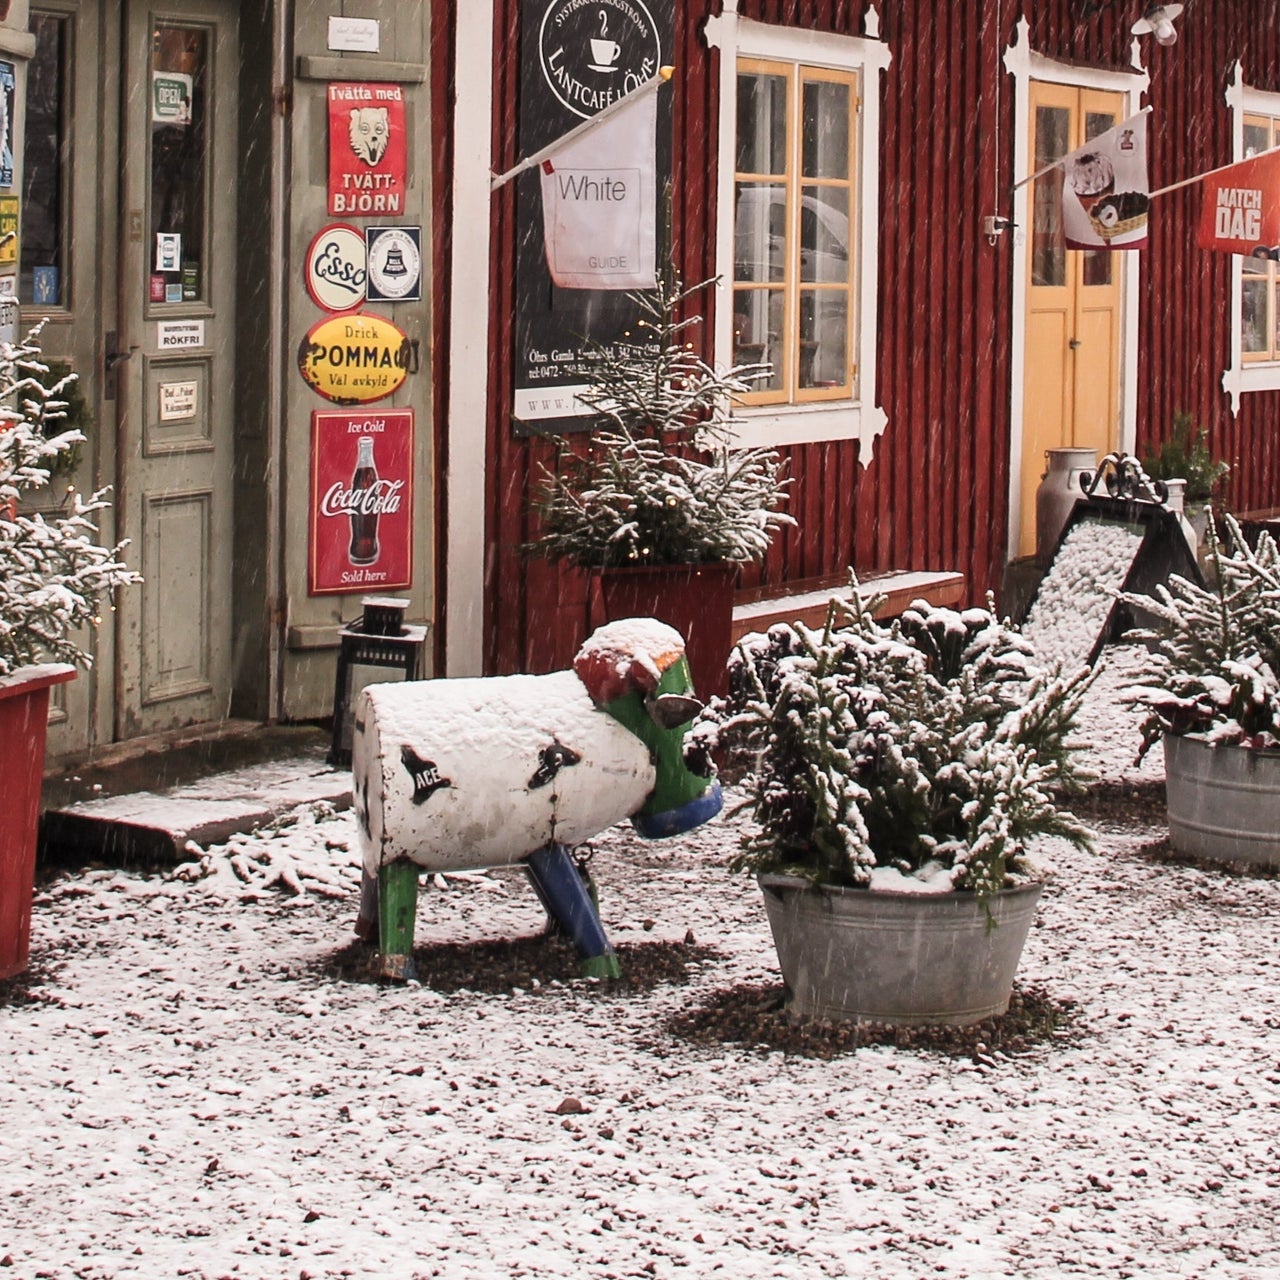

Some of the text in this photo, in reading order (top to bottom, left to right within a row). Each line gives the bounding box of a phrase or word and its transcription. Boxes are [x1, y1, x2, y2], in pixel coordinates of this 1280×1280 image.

[548, 46, 613, 109] LANTCAFÉ
[624, 57, 655, 96] ÖHR
[159, 87, 181, 104] OPEN
[328, 86, 402, 101] Tvätta med
[342, 171, 396, 189] TVÄTT-
[558, 175, 626, 201] White
[333, 190, 400, 212] BJÖRN
[1217, 187, 1262, 209] MATCH
[1215, 207, 1262, 241] DAG
[315, 242, 366, 293] Esso
[588, 256, 627, 269] GUIDE
[163, 335, 200, 345] RÖKFRI
[345, 325, 379, 339] Drick
[529, 349, 548, 363] Öhrs
[551, 349, 575, 362] Gamla
[352, 374, 388, 388] avkyld
[347, 420, 386, 433] Ice Cold
[321, 479, 405, 517] Coca-Cola
[340, 569, 387, 584] Sold here
[415, 767, 442, 789] ACE
